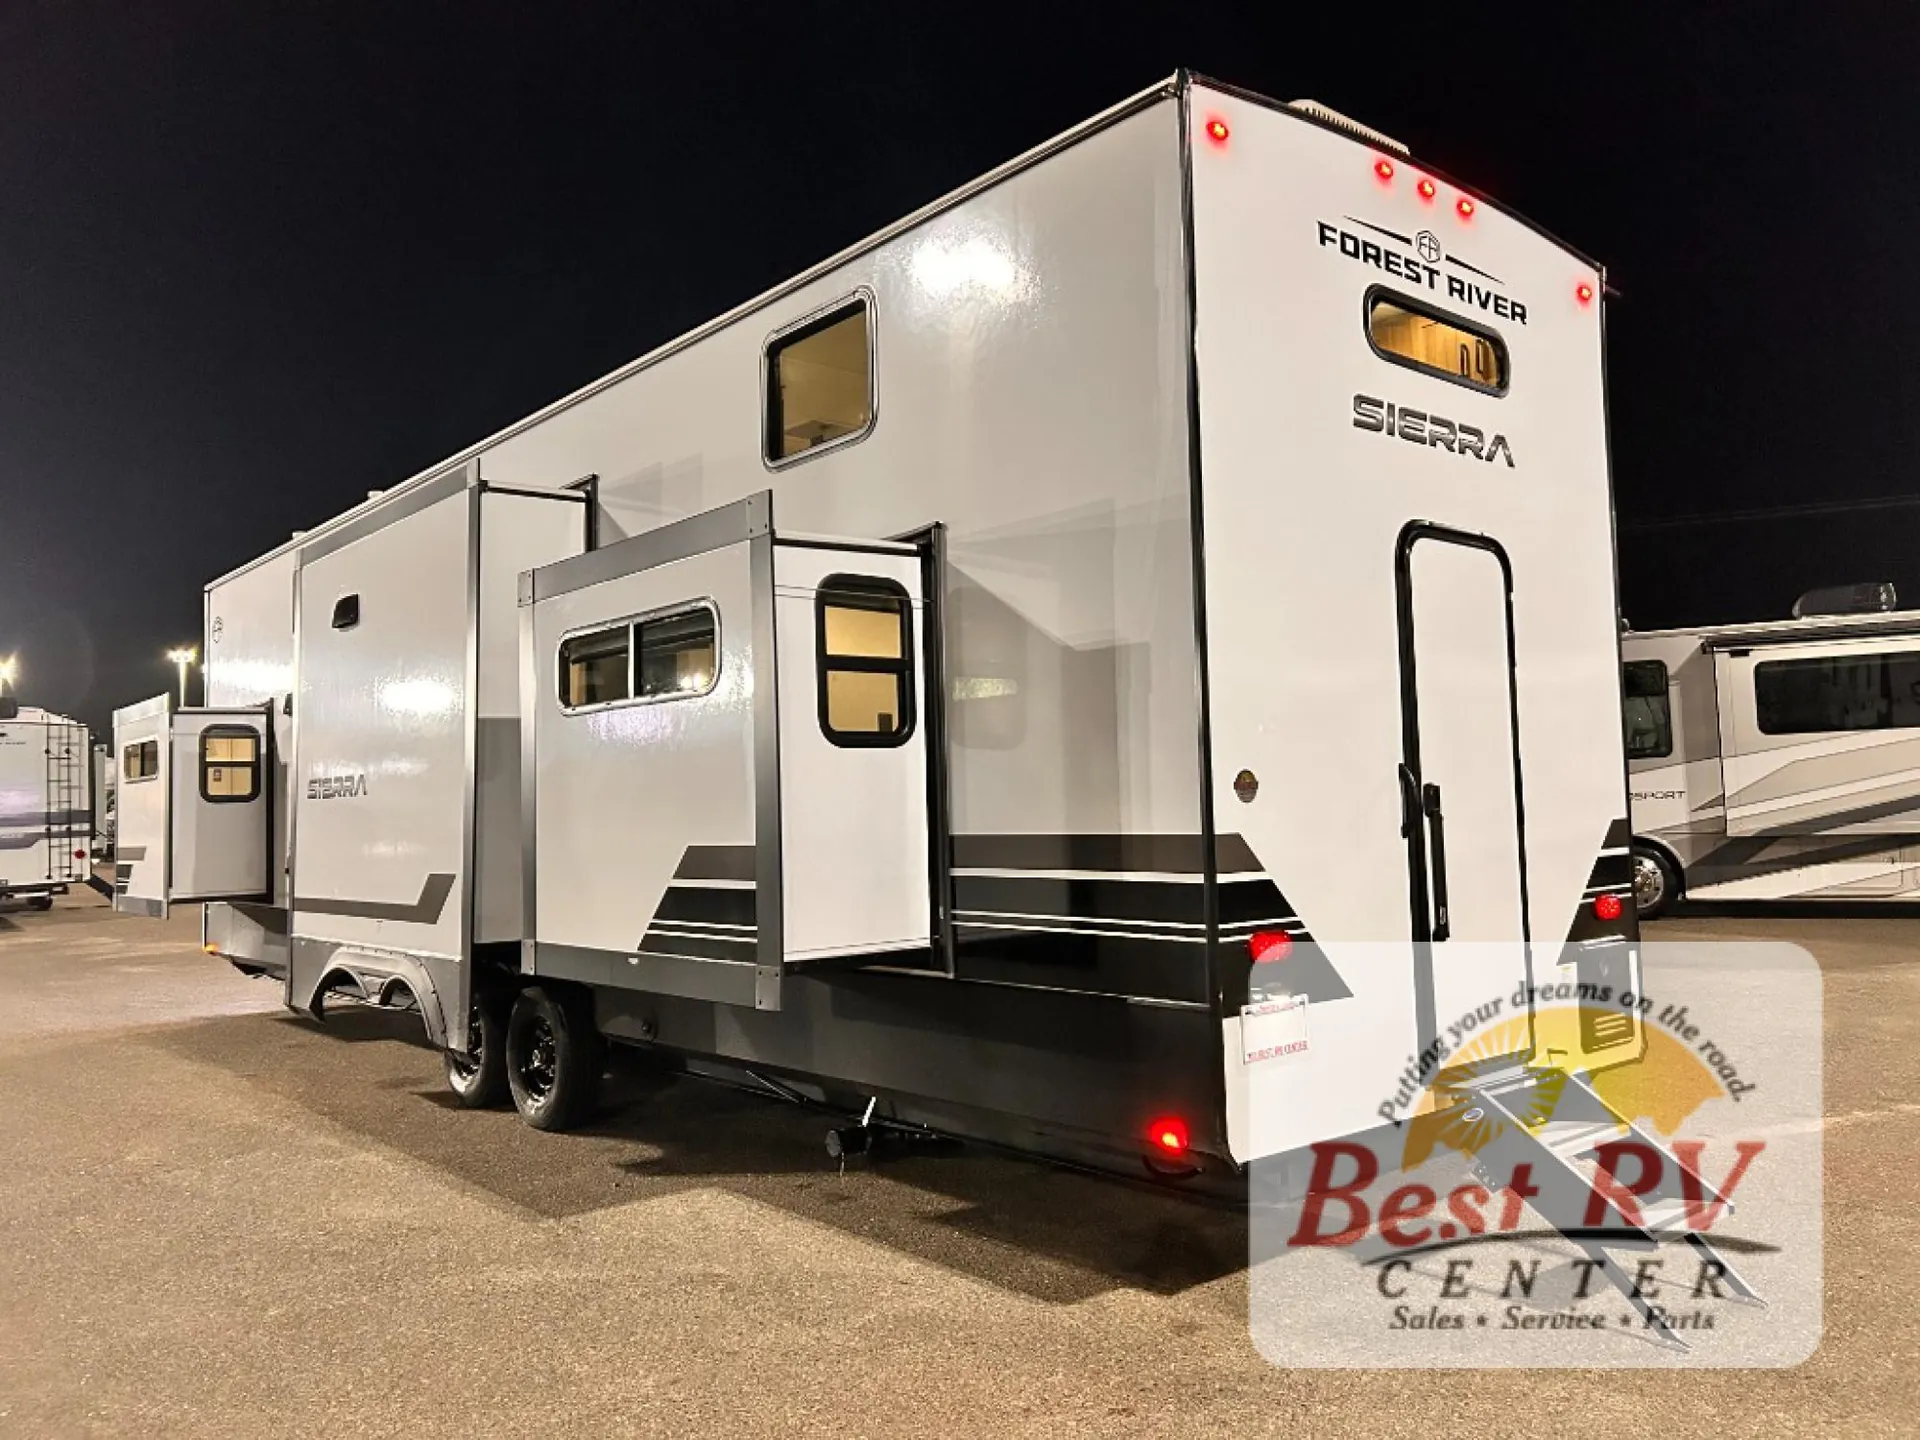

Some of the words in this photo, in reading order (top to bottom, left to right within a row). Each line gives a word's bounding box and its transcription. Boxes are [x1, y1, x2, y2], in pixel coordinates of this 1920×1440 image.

[1317, 220, 1440, 289] FOREST
[1447, 274, 1527, 325] RIVER
[1353, 393, 1515, 469] SIERRA
[307, 774, 369, 800] SIERRA
[1629, 790, 1686, 801] SPORT
